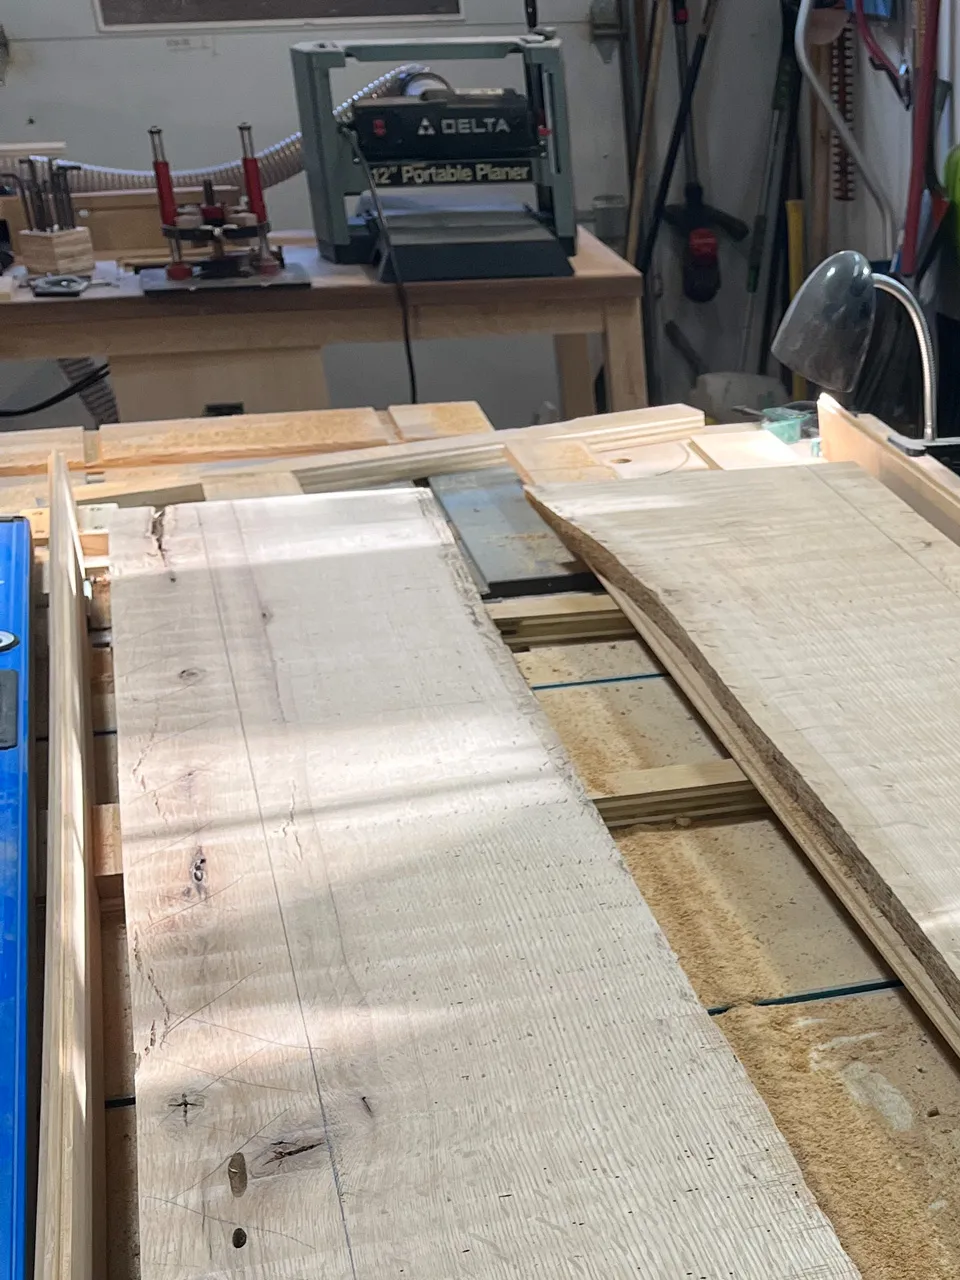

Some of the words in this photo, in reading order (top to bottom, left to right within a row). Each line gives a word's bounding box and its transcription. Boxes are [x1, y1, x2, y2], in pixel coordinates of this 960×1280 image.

[440, 117, 511, 134] DELTA
[371, 166, 398, 184] 12"
[402, 164, 473, 184] Portable
[475, 163, 530, 181] Planer
